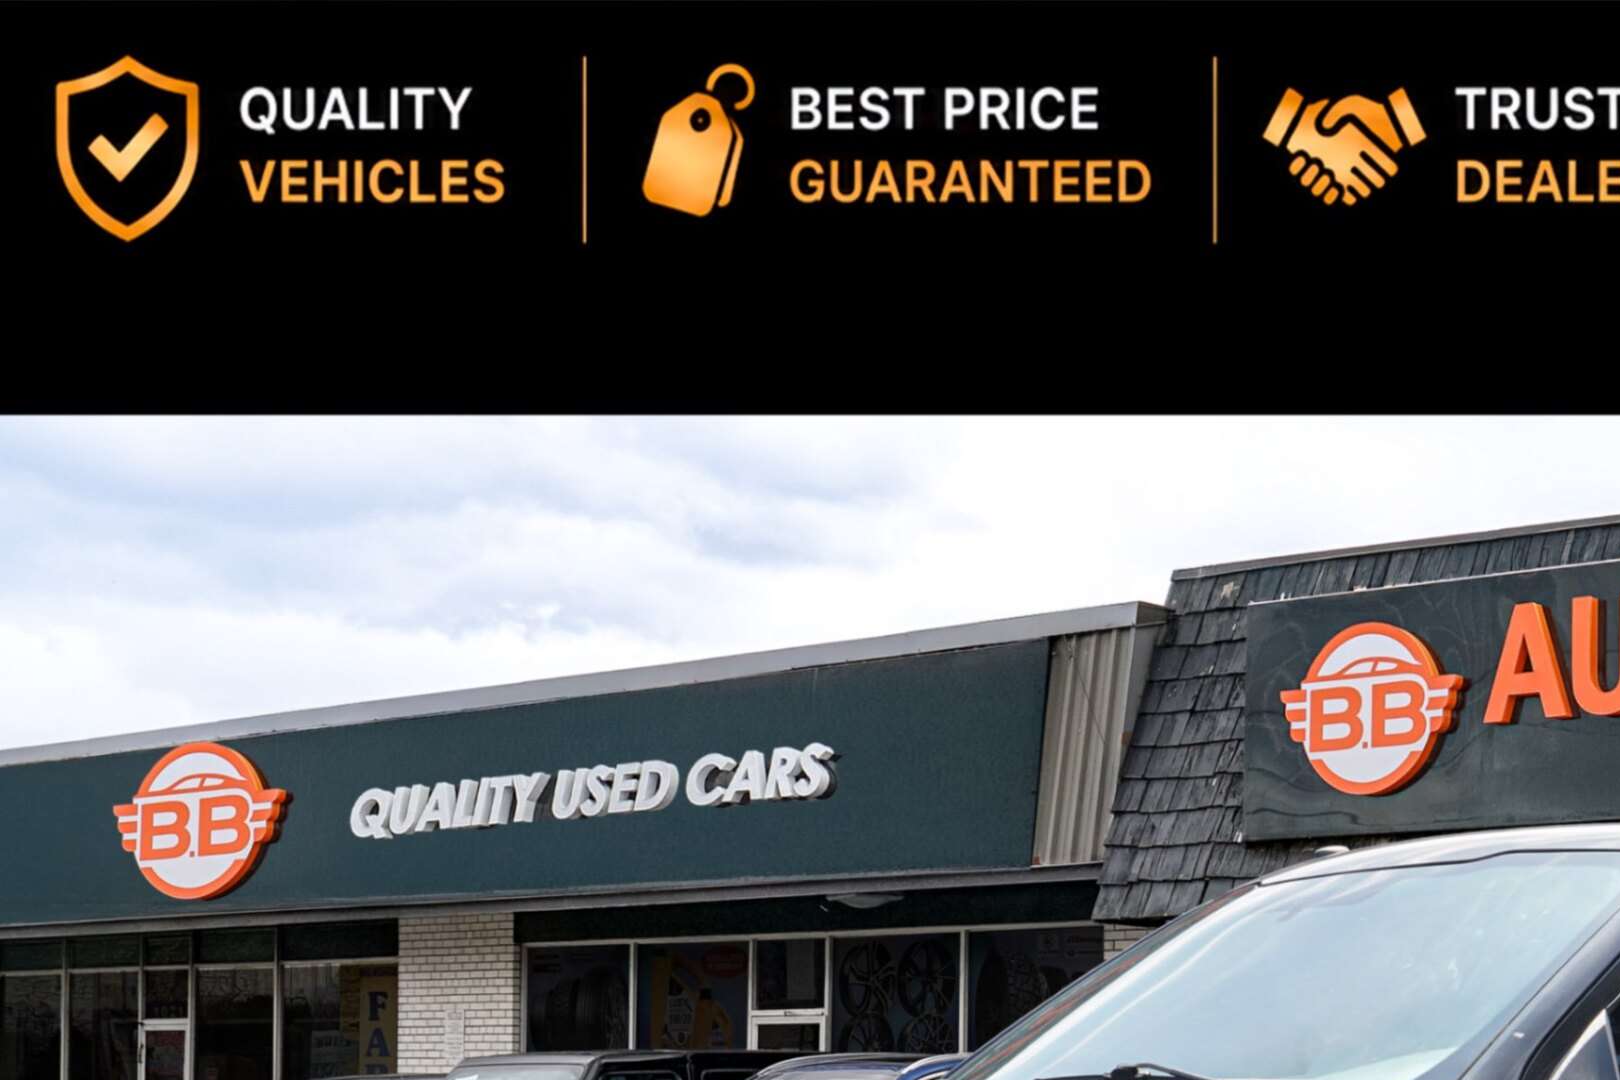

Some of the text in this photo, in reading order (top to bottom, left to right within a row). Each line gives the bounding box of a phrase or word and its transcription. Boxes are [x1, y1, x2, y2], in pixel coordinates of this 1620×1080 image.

[349, 742, 837, 840] QUALITY USED CARS
